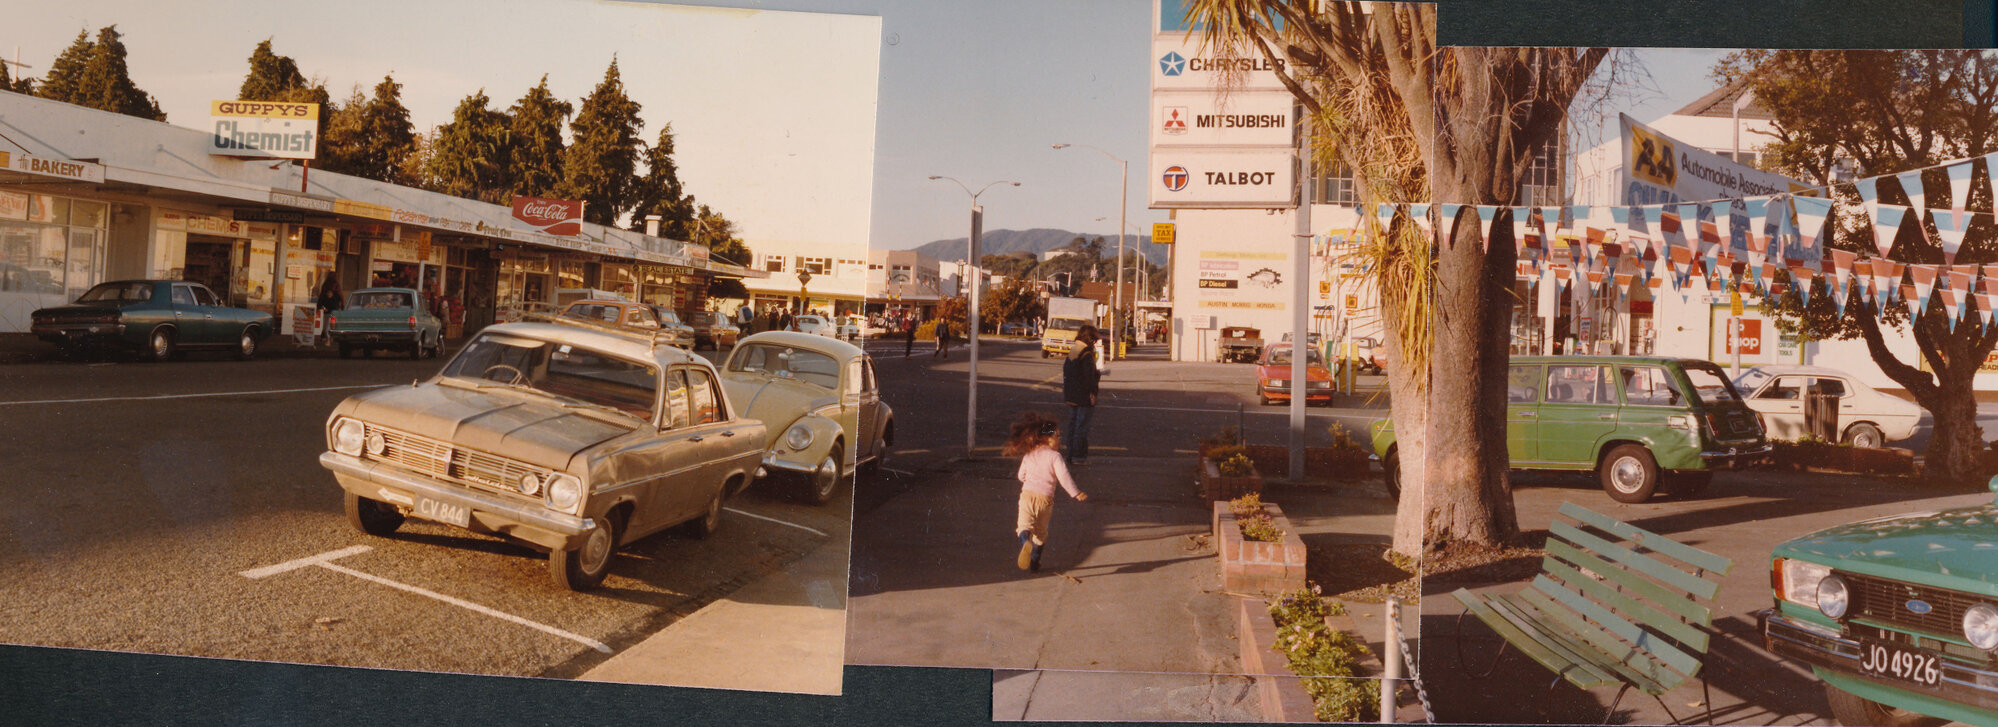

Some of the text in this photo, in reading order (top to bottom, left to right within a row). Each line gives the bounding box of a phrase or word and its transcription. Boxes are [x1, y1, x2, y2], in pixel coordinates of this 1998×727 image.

[219, 102, 308, 116] GUPPYS
[1196, 115, 1285, 128] MITSUBISHI
[215, 120, 313, 151] Chemist
[31, 158, 85, 177] BAKERY
[1634, 138, 1674, 184] AA
[1205, 172, 1275, 185] TALBOT
[1681, 152, 1737, 190] Automobile
[523, 202, 569, 219] Coca-Cola
[641, 264, 688, 274] REAL ESTATE
[1728, 337, 1759, 350] op
[421, 497, 464, 524] CV 844
[1863, 644, 1937, 685] JO 4926
